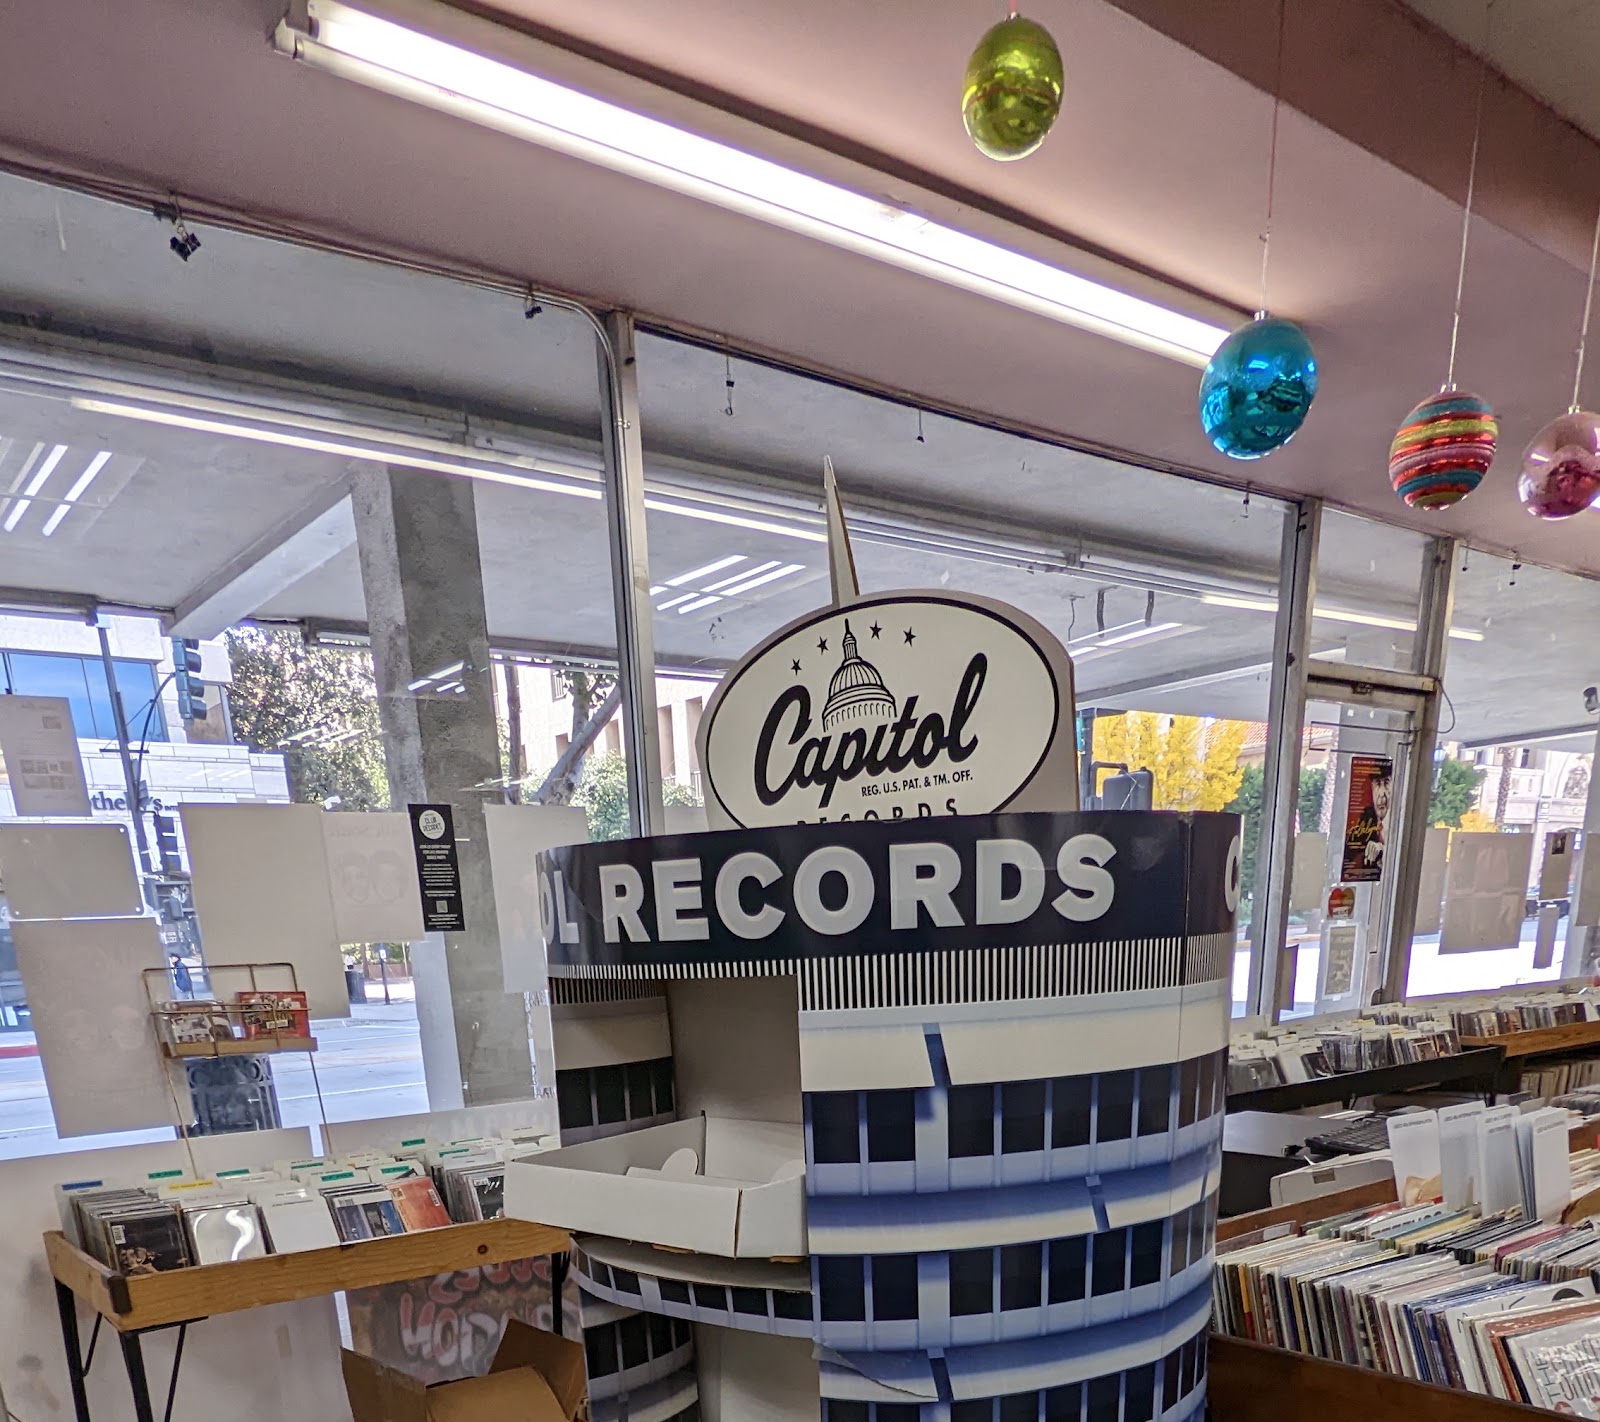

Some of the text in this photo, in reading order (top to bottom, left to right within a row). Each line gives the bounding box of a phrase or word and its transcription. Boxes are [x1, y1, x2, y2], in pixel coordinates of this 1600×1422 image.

[754, 652, 988, 809] Capitol
[861, 769, 973, 797] REG. U.S. PAT. & TM. OFF.
[599, 833, 1117, 943] RECORDS
